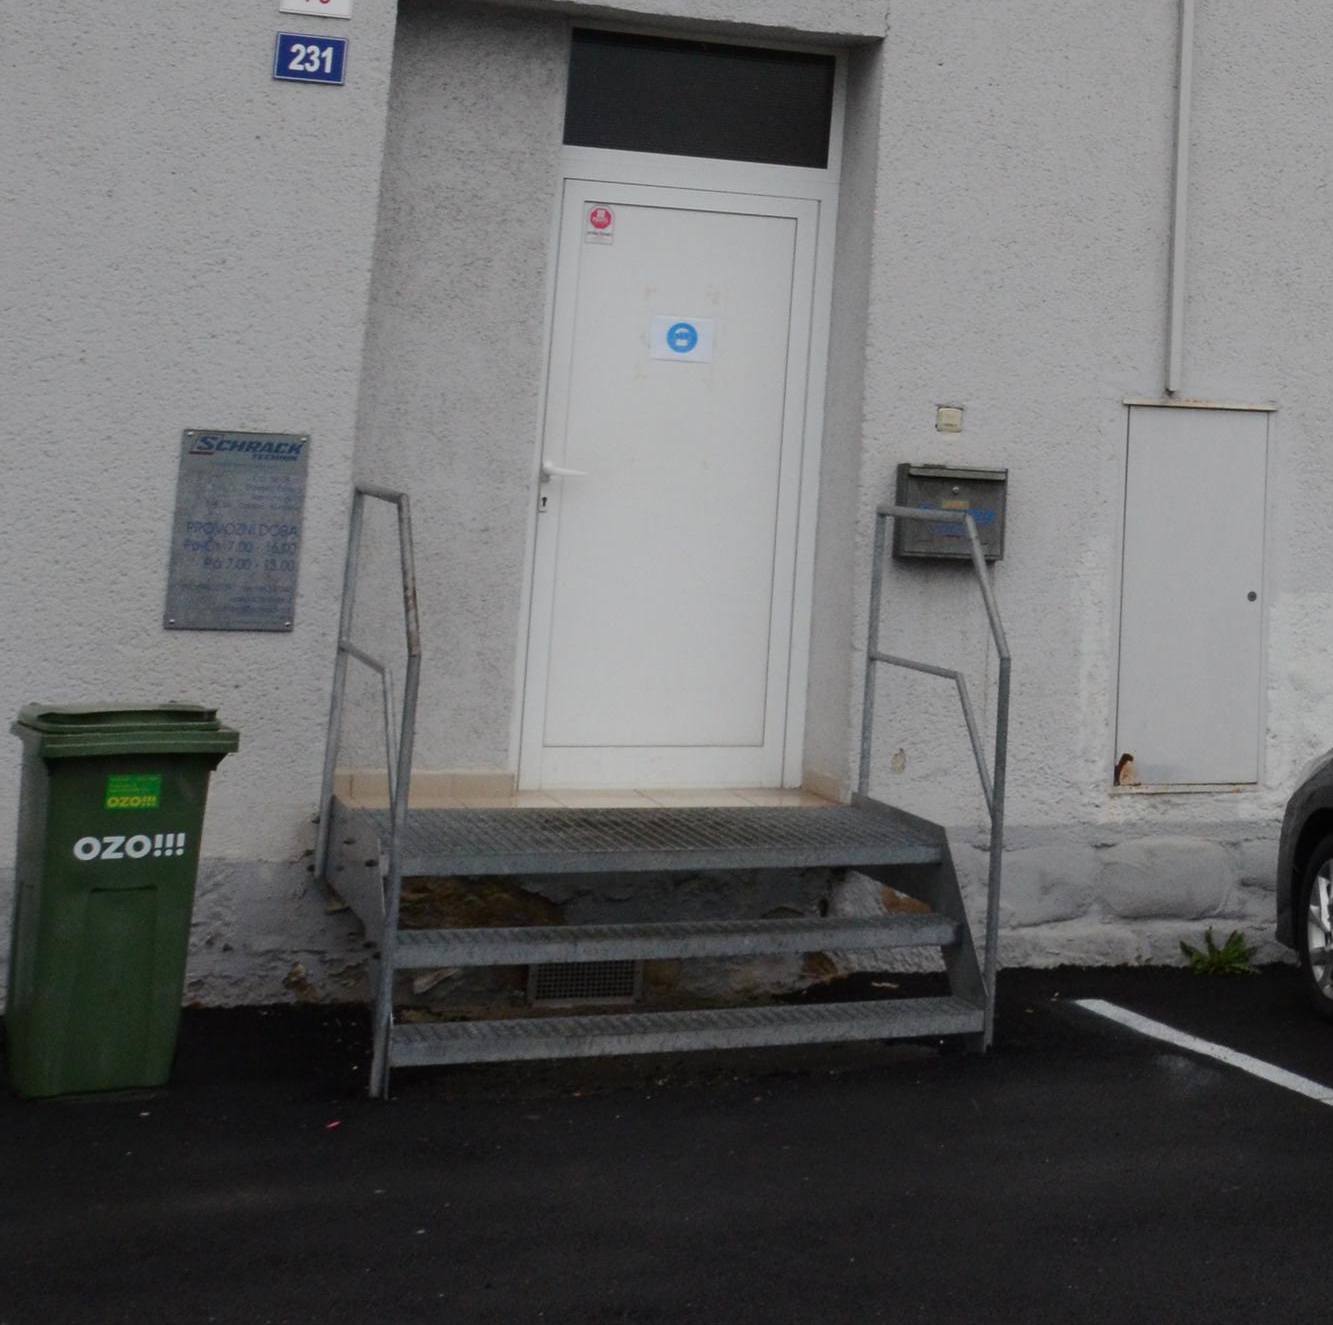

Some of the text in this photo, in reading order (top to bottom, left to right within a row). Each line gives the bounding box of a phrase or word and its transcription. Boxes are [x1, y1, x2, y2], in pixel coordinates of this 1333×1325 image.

[288, 43, 334, 74] 231
[197, 436, 303, 454] SCHRACK
[107, 795, 156, 807] OZO!!!
[73, 832, 186, 861] OZO!!!
